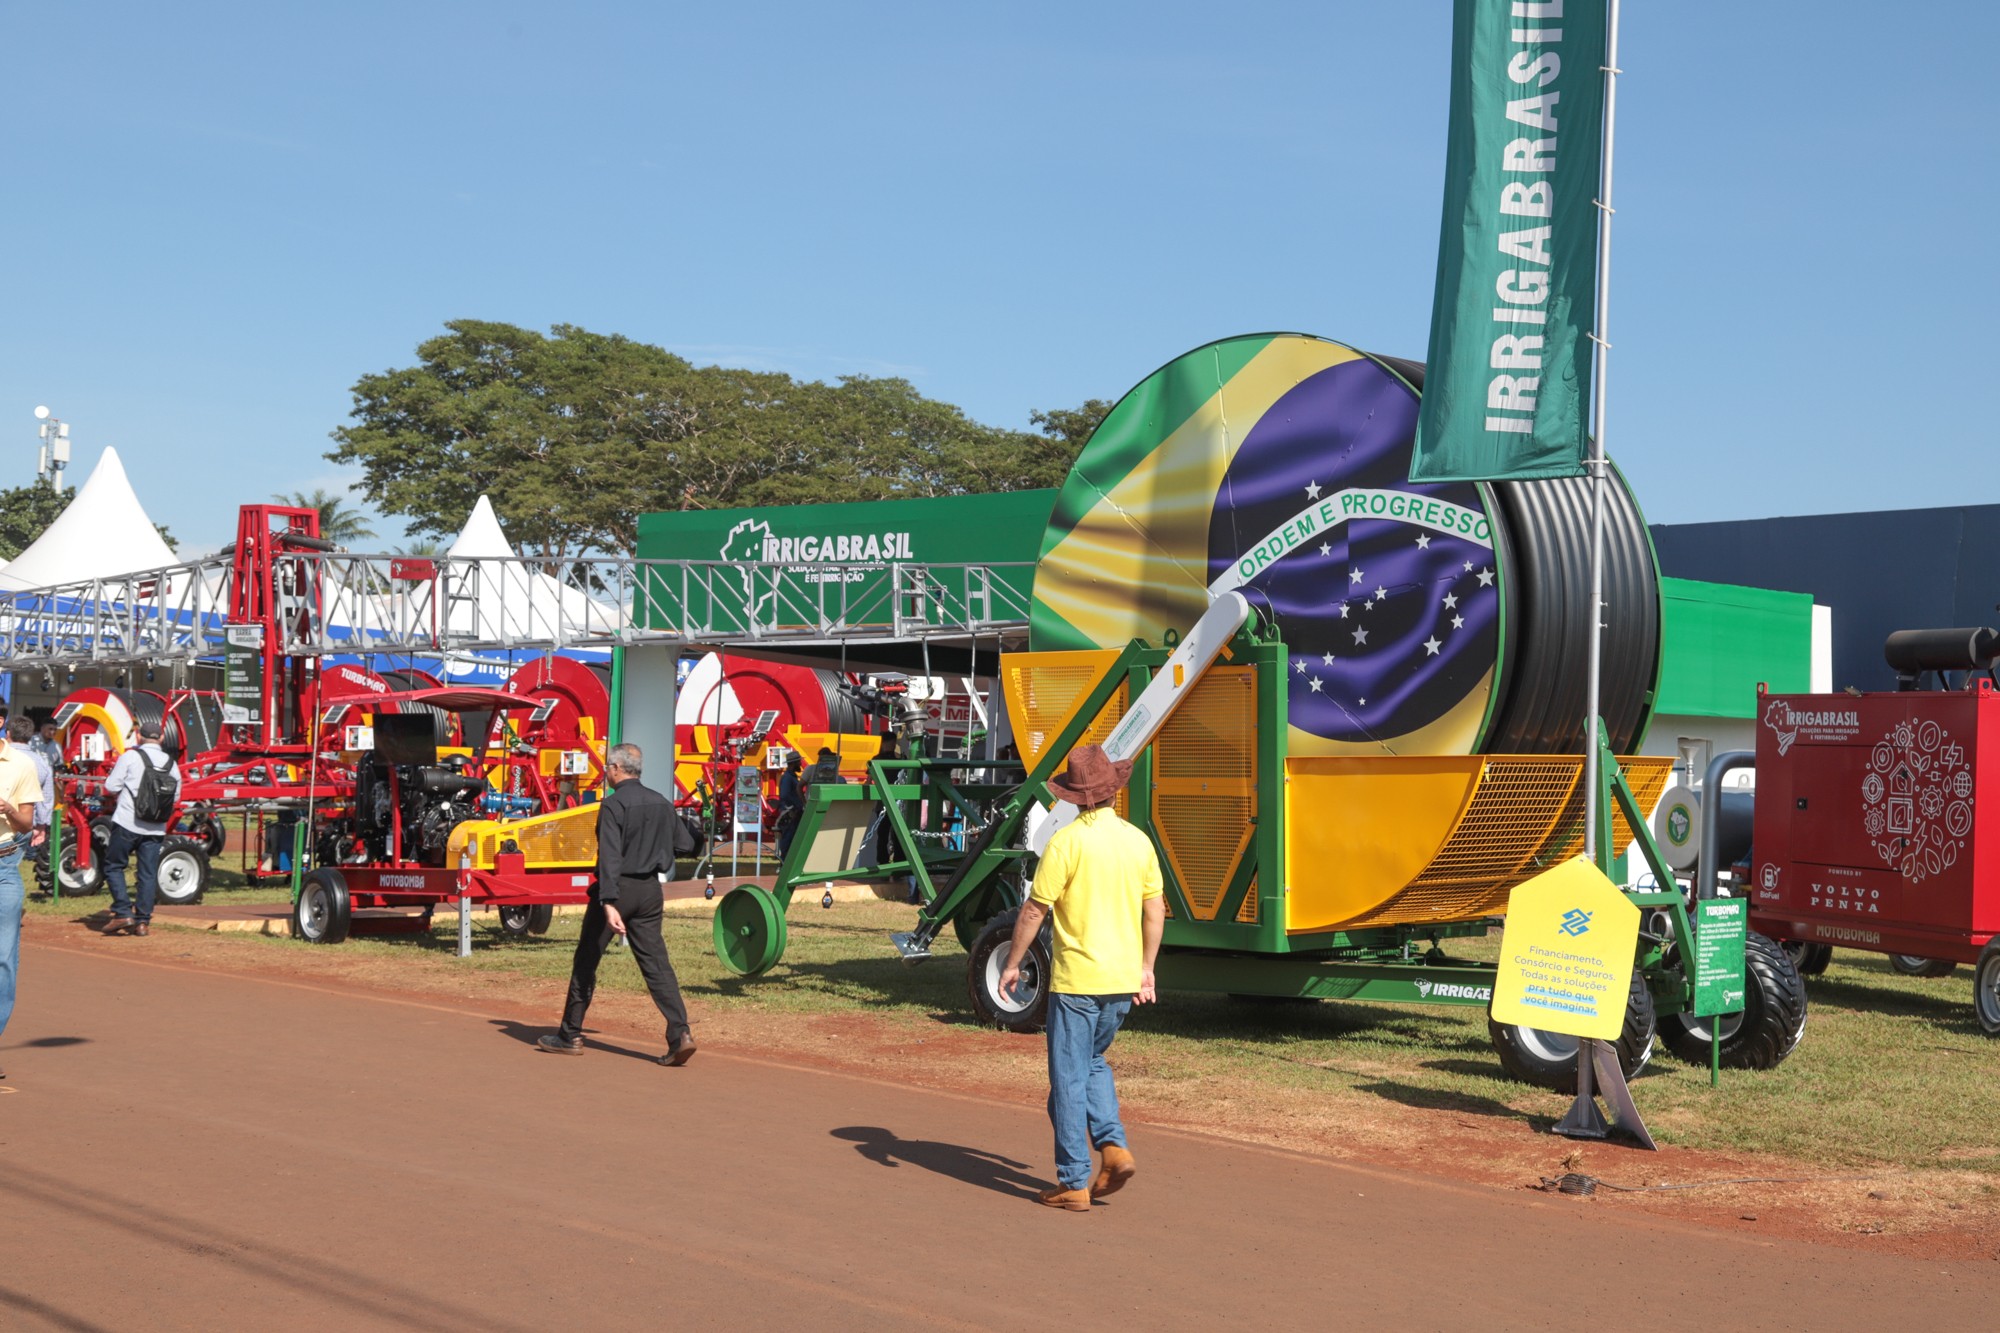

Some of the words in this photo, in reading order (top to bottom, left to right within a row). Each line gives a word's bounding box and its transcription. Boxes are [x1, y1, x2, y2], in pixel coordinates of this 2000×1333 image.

[1485, 0, 1564, 434] IRRIGABRASIL
[1240, 515, 1315, 578] ORDEM
[1322, 503, 1336, 524] E
[1341, 494, 1491, 540] PROGRESSO
[762, 533, 913, 562] IRRIGABRASIL
[341, 667, 386, 694] TURBOMAQ
[1786, 711, 1859, 726] IRRIGABRASIL
[1835, 727, 1859, 735] IRRIGAÇÃO
[1828, 868, 1854, 876] POWERED
[380, 875, 424, 889] MOTOBOMBA
[1811, 883, 1879, 899] VOLVO
[1760, 890, 1780, 900] BioFuel
[1705, 904, 1740, 917] TURBOMAQ
[1811, 896, 1879, 913] PENTA
[1816, 925, 1880, 944] MOTOBOMBA
[1529, 945, 1605, 968] Financiamento,
[1514, 955, 1563, 971] Consórcio
[1573, 966, 1616, 981] Seguros.
[1520, 968, 1549, 982] Todas
[1551, 975, 1561, 984] as
[1564, 977, 1607, 992] soluções
[1528, 984, 1546, 993] pra
[1549, 986, 1573, 998] tudo
[1575, 993, 1594, 1002] que
[1525, 995, 1548, 1006] você
[1550, 998, 1598, 1015] imaginar.
